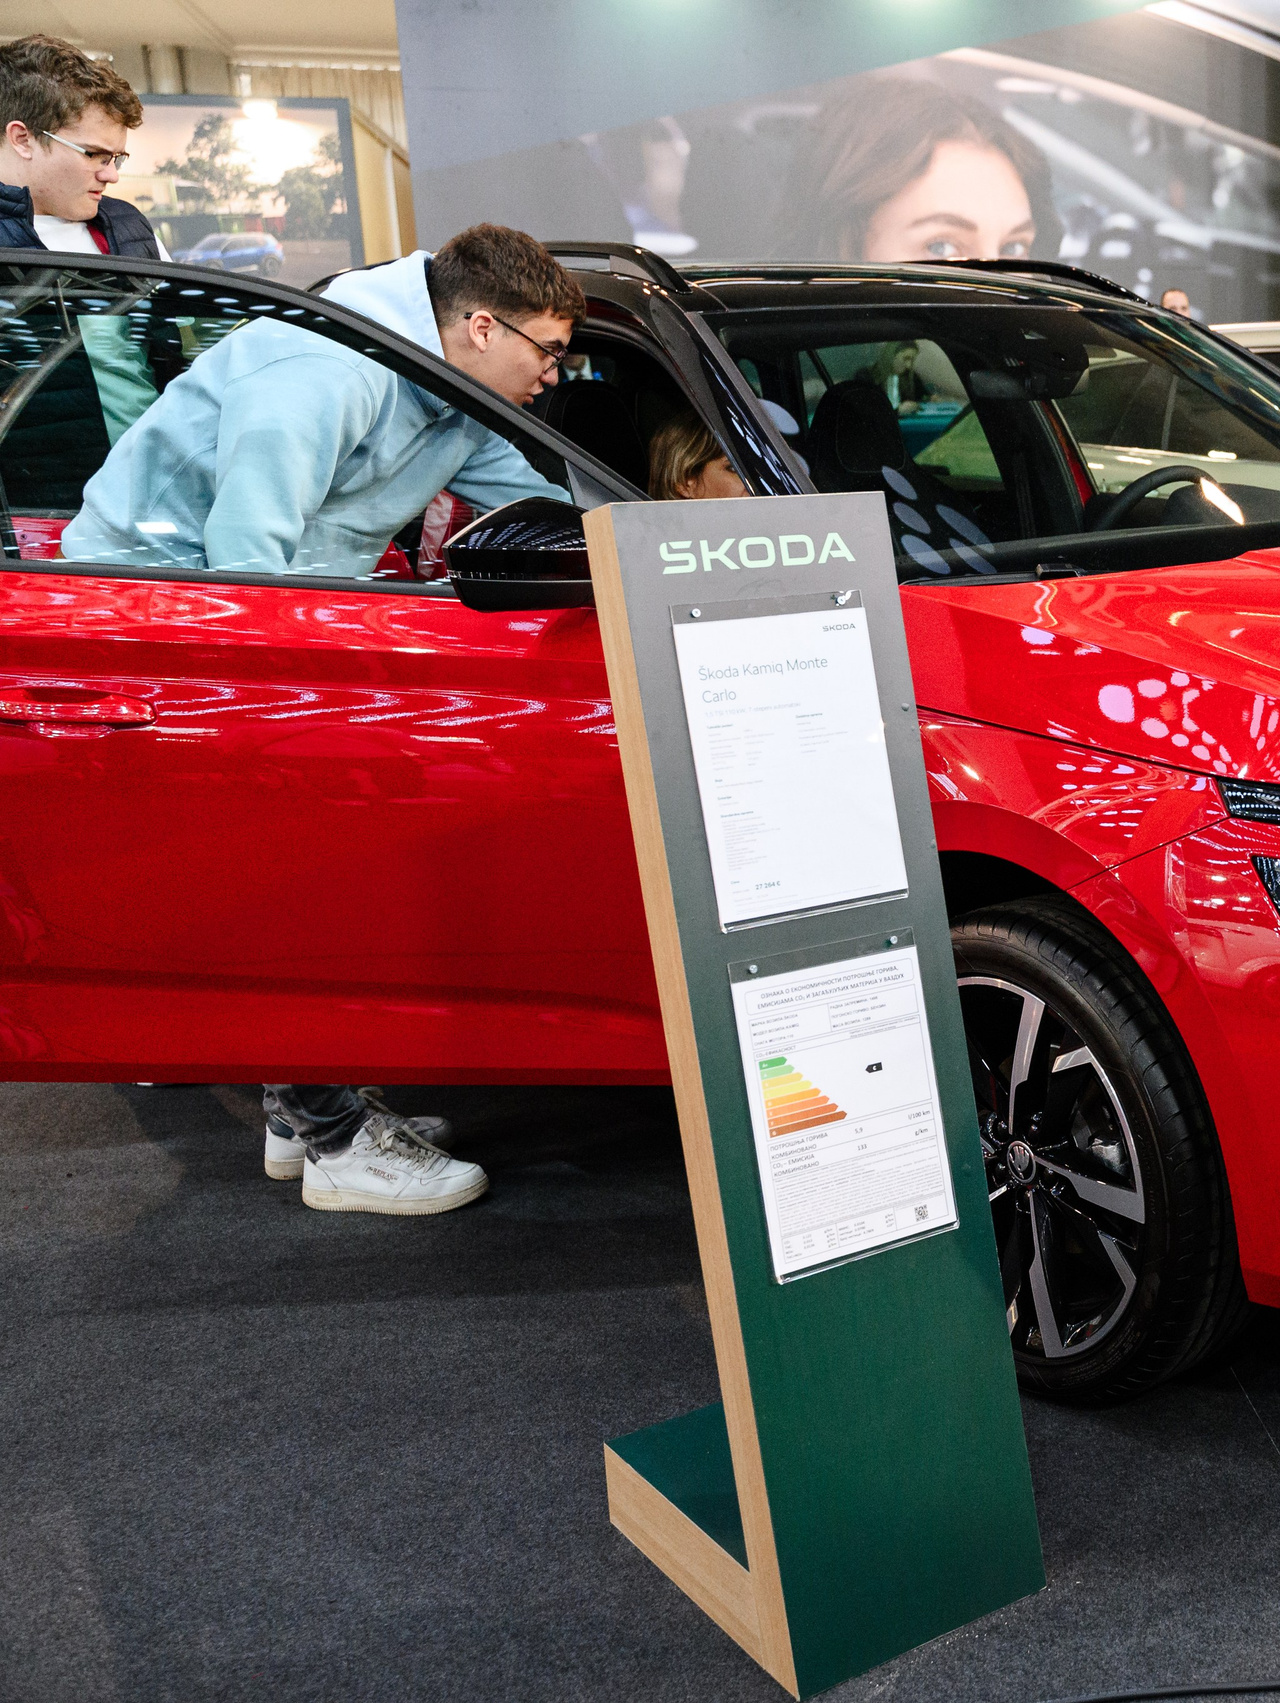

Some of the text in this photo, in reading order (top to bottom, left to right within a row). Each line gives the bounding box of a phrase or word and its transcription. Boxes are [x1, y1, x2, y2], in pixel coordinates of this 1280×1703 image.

[698, 657, 829, 681] Škoda Kamiq Monte
[702, 688, 737, 704] Carlo
[757, 996, 794, 1009] ЕМИСИЈАМА
[849, 978, 879, 990] МАТЕРИЈА
[884, 973, 905, 983] ВАЗДУХ
[760, 989, 785, 1000] ОЗНАКА
[791, 977, 842, 993] ЕКОНОМИЧНОСТИ
[842, 969, 876, 982] ПОТРОШЊЕ
[769, 1132, 828, 1151] ПОТРОШЊА ГОРИВА
[857, 1143, 868, 1151] 133
[771, 1143, 818, 1160] КОМБИНОВАНО
[788, 1153, 815, 1165] ЕМИСИЈА
[773, 1160, 820, 1177] КОМБИНОВАНО
